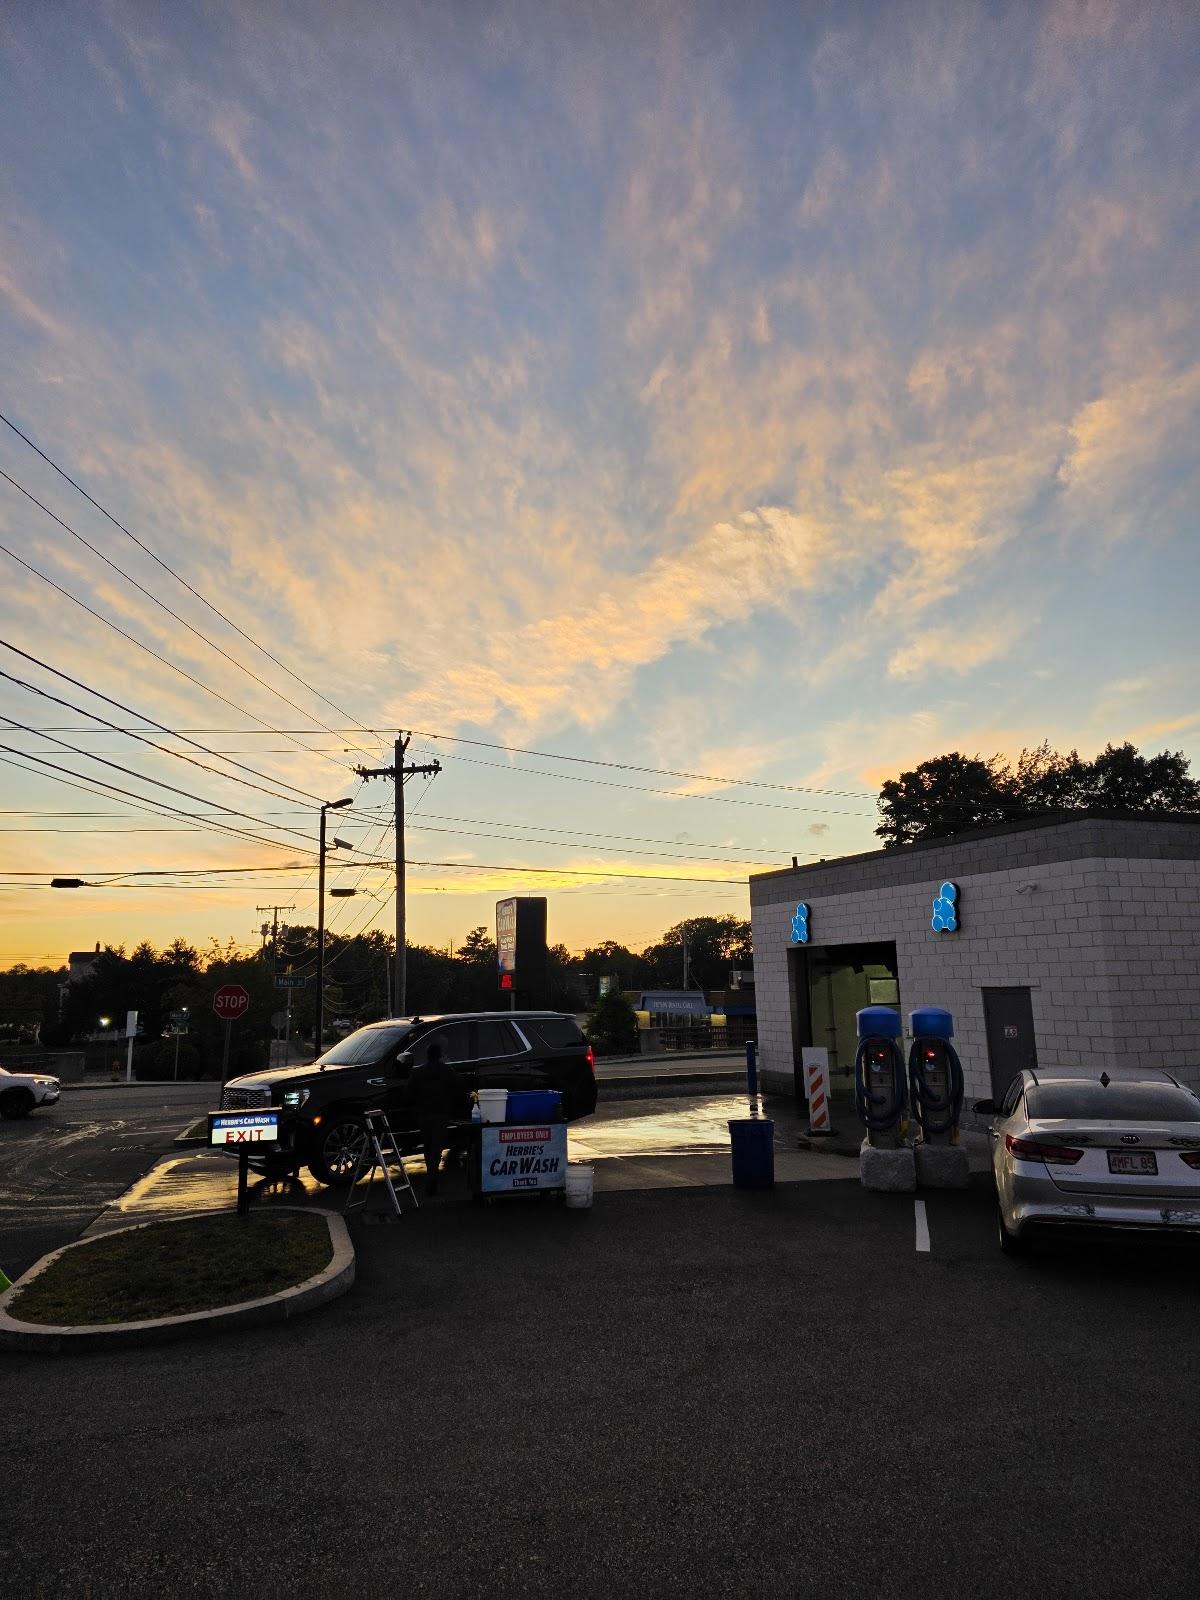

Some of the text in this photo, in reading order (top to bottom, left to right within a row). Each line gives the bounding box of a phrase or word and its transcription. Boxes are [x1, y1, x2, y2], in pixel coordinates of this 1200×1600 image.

[215, 995, 247, 1008] STOP
[220, 1116, 270, 1126] HERBIE'S CAR WASH
[226, 1129, 264, 1145] EXIT
[501, 1130, 549, 1141] EMPLOYEES ONLY
[506, 1145, 544, 1157] HERBIE'S
[490, 1157, 559, 1176] CAR WASH
